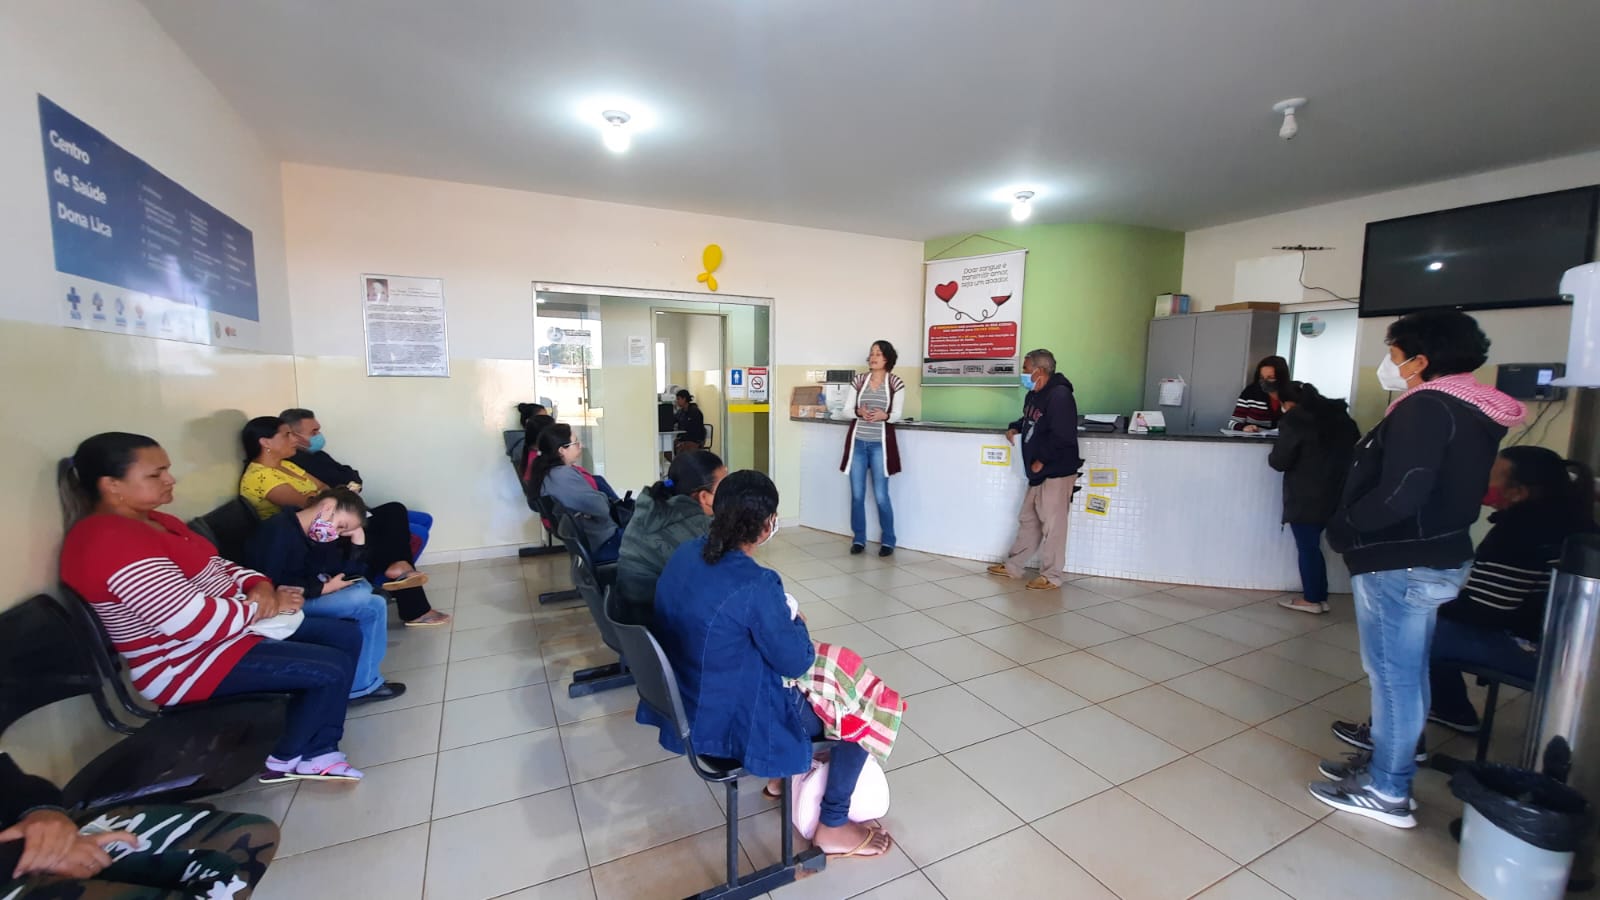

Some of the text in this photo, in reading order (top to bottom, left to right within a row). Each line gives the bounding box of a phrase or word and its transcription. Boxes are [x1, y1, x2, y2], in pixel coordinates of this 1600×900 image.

[49, 130, 90, 165] Centro
[54, 166, 107, 204] de Saúde
[57, 201, 112, 237] Dona Lica
